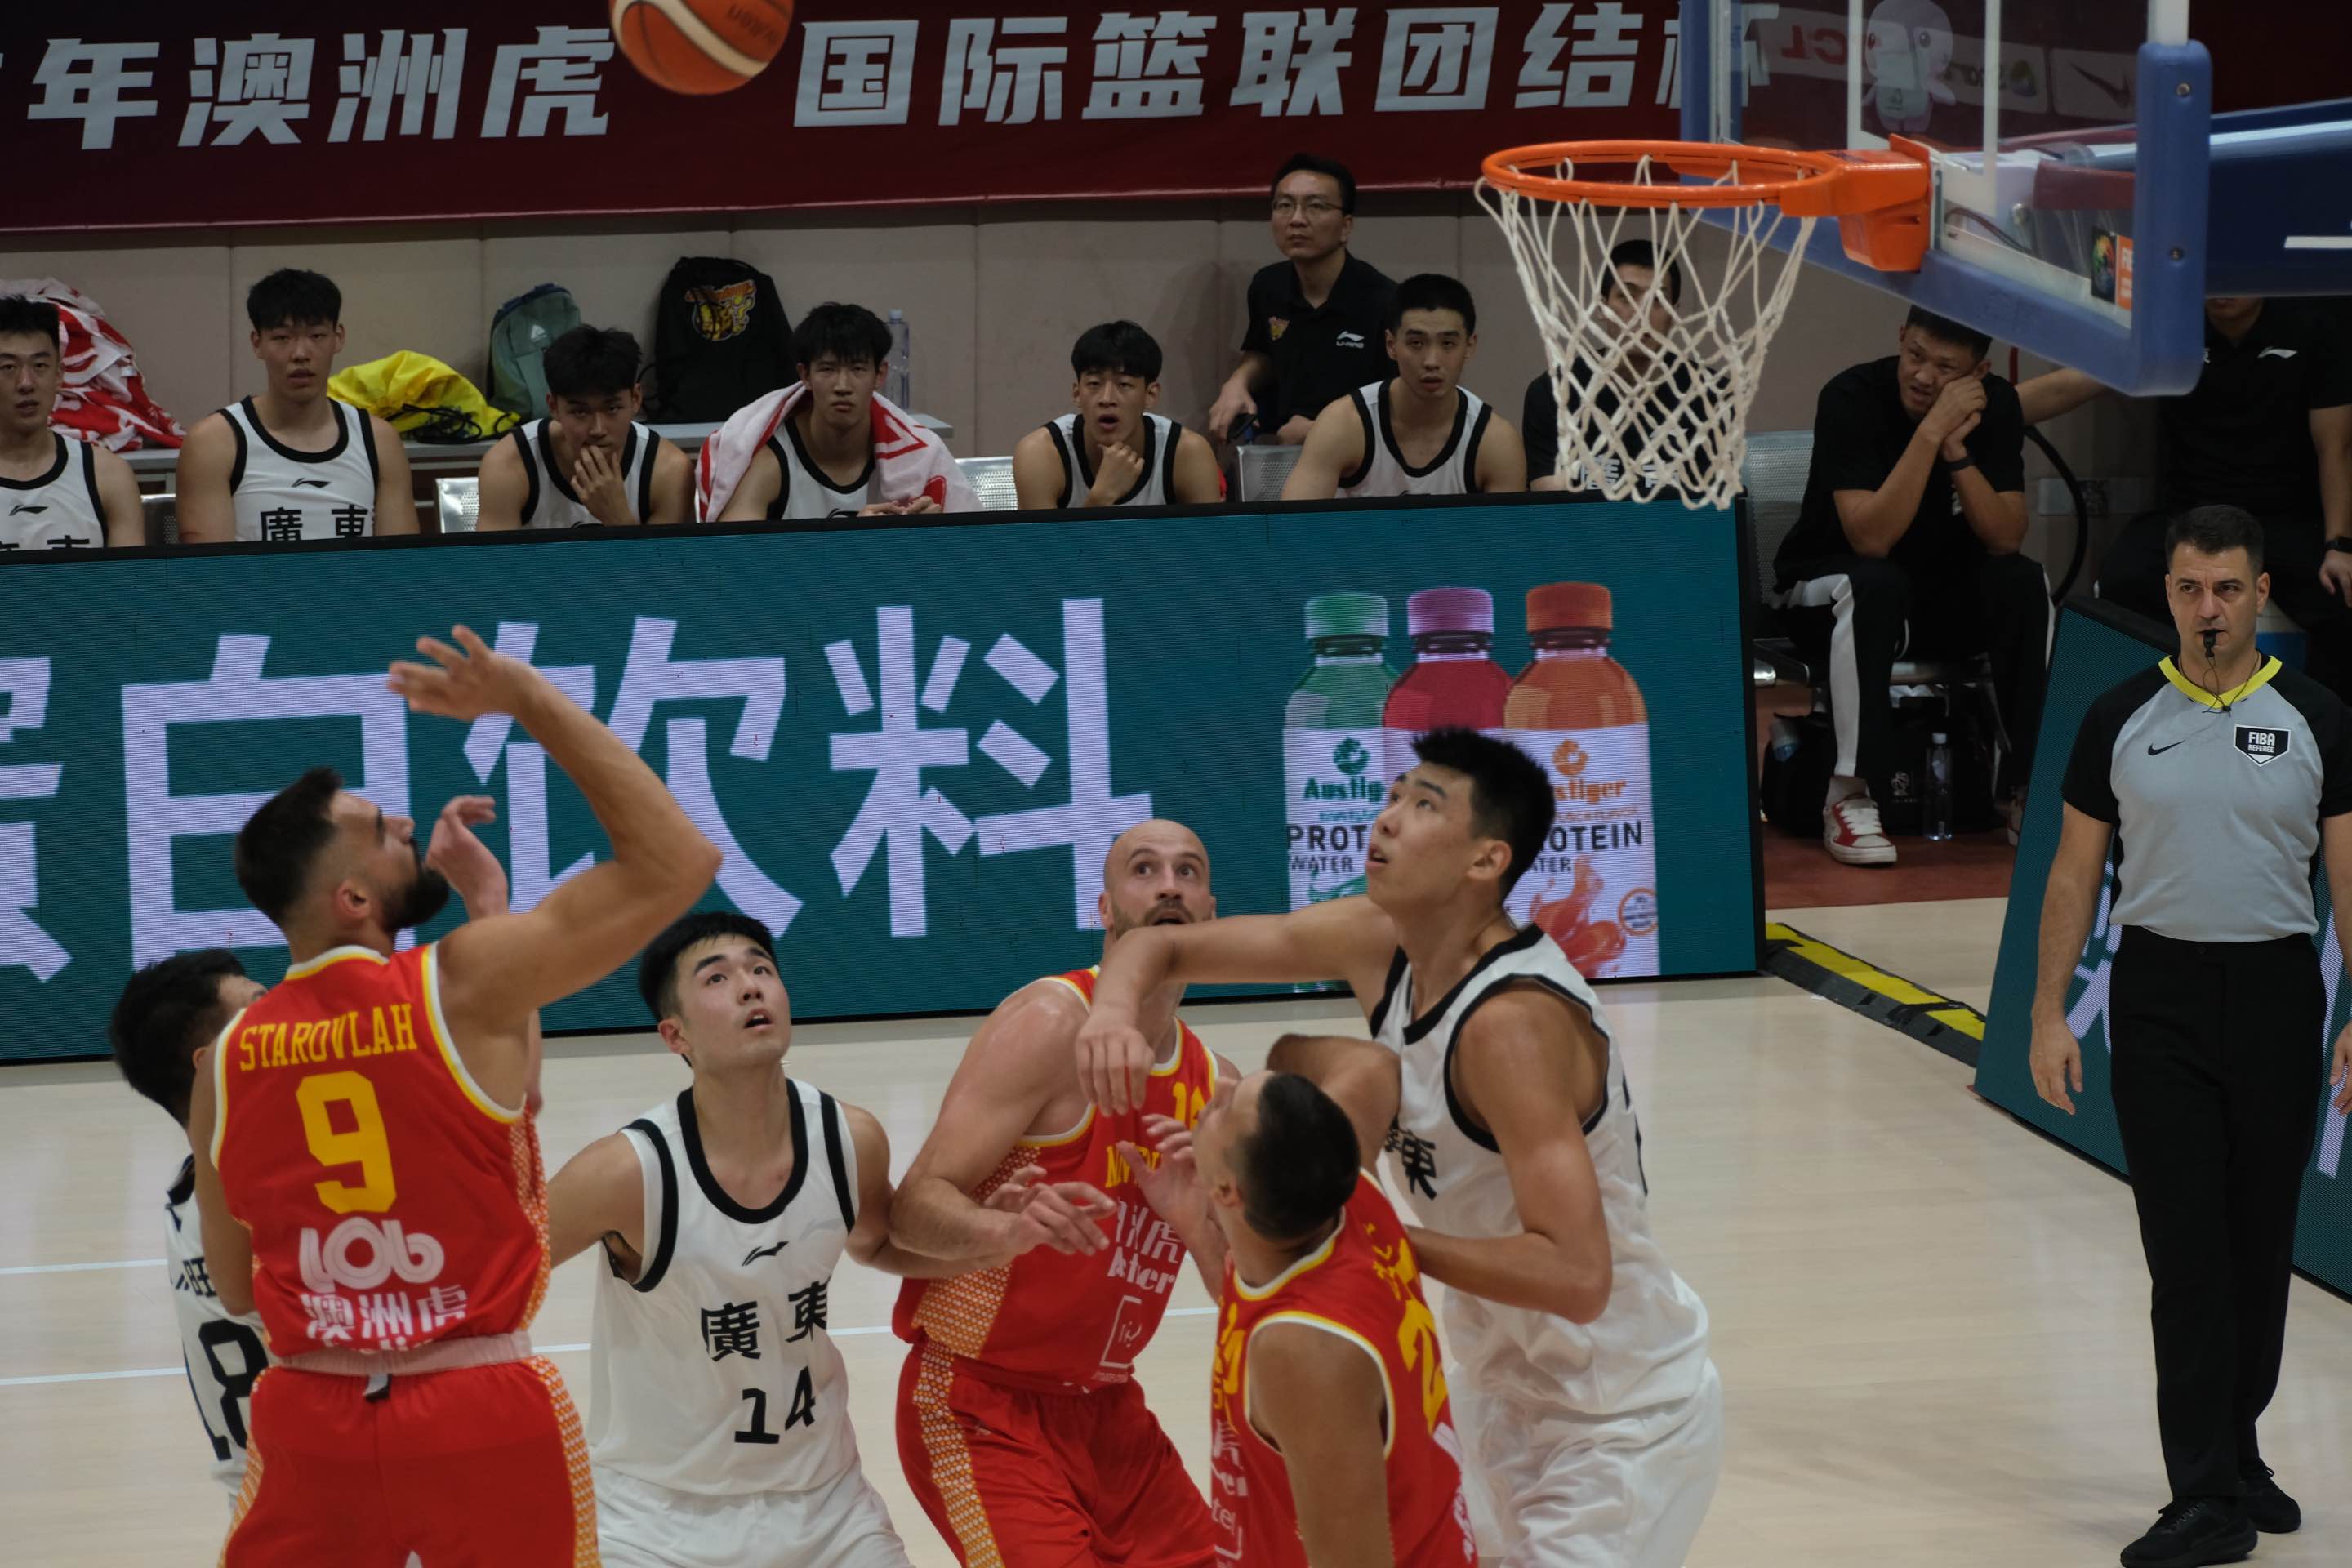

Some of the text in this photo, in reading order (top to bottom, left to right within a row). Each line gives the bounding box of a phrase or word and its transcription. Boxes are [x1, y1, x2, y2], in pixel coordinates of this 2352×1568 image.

[0, 24, 616, 150] 年澳洲虎
[2247, 731, 2276, 746] FIBA
[2247, 744, 2275, 754] REFEREE
[1287, 823, 1368, 853] PROT
[1548, 820, 1644, 852] OTEIN
[238, 1003, 418, 1071] STAROVLAH
[295, 1071, 398, 1214] 9
[300, 1284, 469, 1348] 澳洲虎
[700, 1280, 827, 1362] 廣東
[733, 1365, 816, 1444] 14
